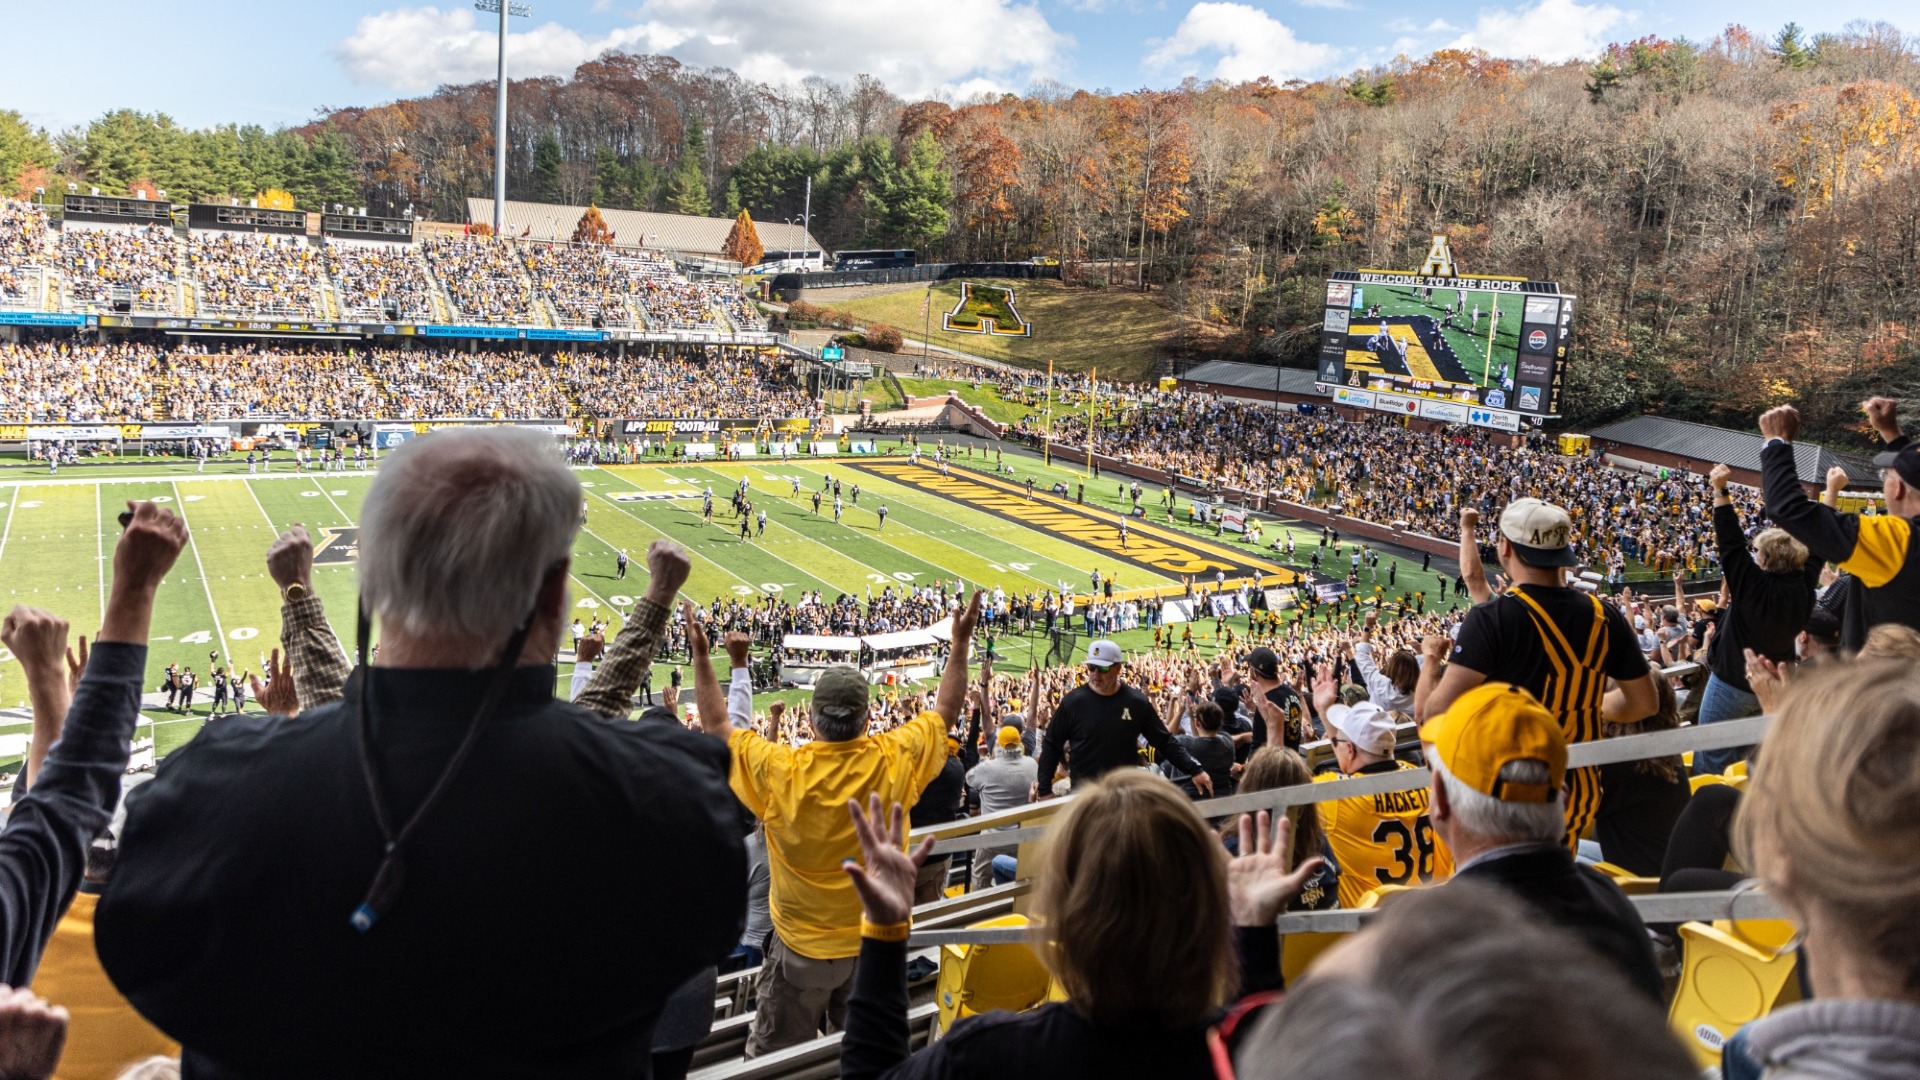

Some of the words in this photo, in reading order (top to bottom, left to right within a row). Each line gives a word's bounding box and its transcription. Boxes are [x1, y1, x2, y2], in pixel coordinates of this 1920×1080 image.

[1359, 273, 1424, 286] WELCOME
[1427, 276, 1446, 287] TO
[1449, 278, 1476, 289] THE
[1481, 280, 1522, 292] ROCK
[1327, 310, 1345, 320] UNC
[1316, 385, 1326, 393] 40
[1412, 380, 1431, 389] 10:06
[1348, 395, 1370, 406] Lottery
[1378, 398, 1404, 408] BlueRidge
[1492, 413, 1508, 421] North
[1531, 417, 1543, 427] 40
[625, 421, 646, 432] APP
[646, 421, 674, 432] STATE
[674, 421, 720, 432] FOOTBALL
[1491, 420, 1516, 429] Carolina
[867, 572, 915, 584] 20
[731, 582, 784, 596] 30
[576, 595, 634, 609] 40
[179, 627, 259, 644] 40
[1120, 706, 1132, 721] A
[1372, 814, 1434, 886] 38
